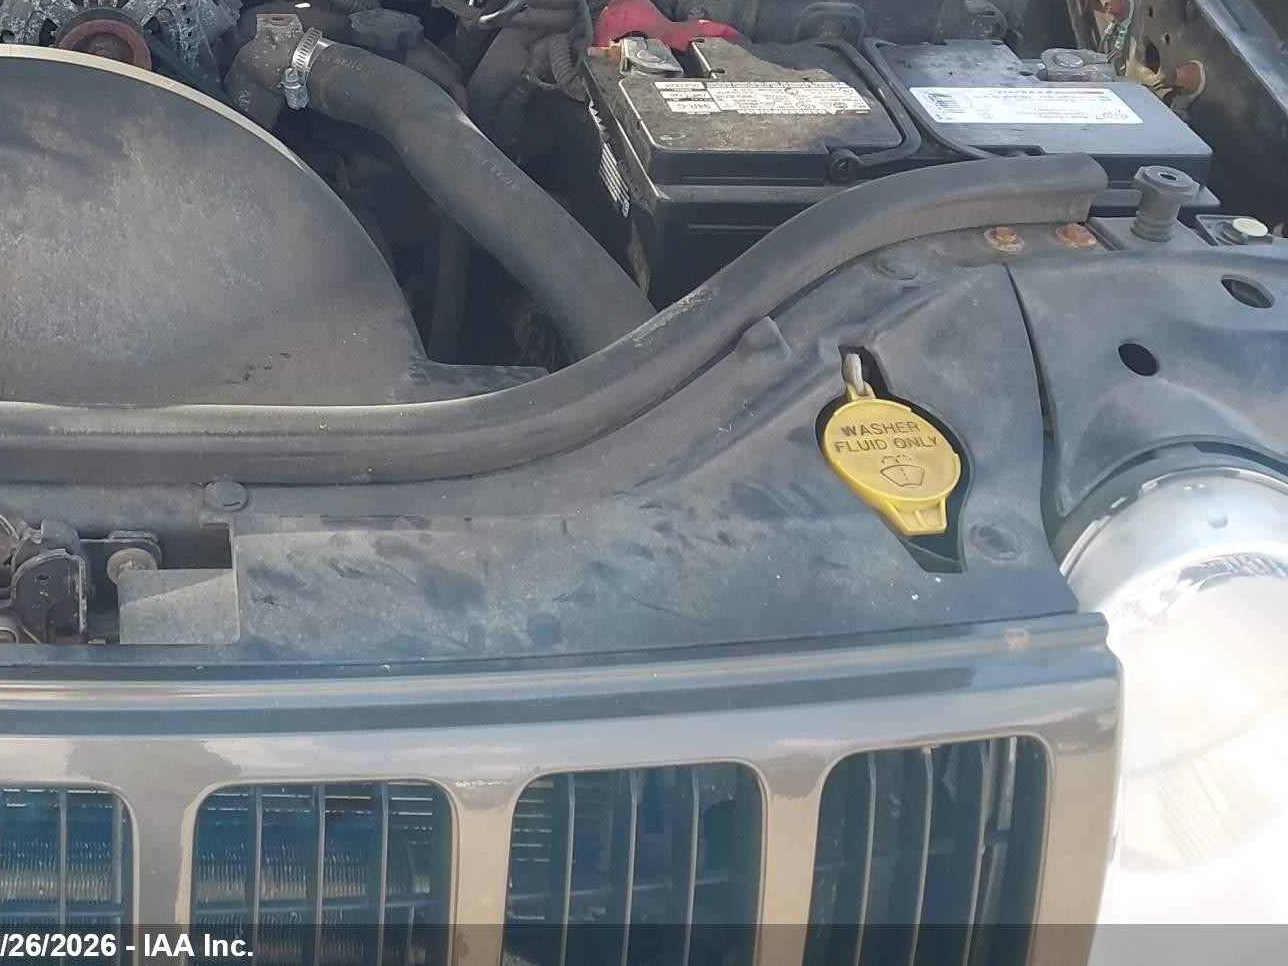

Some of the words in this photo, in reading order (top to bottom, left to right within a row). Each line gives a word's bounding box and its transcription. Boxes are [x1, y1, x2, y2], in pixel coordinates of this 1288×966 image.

[840, 421, 921, 435] WASHER
[835, 437, 888, 452] FLUID
[893, 435, 938, 449] ONLY
